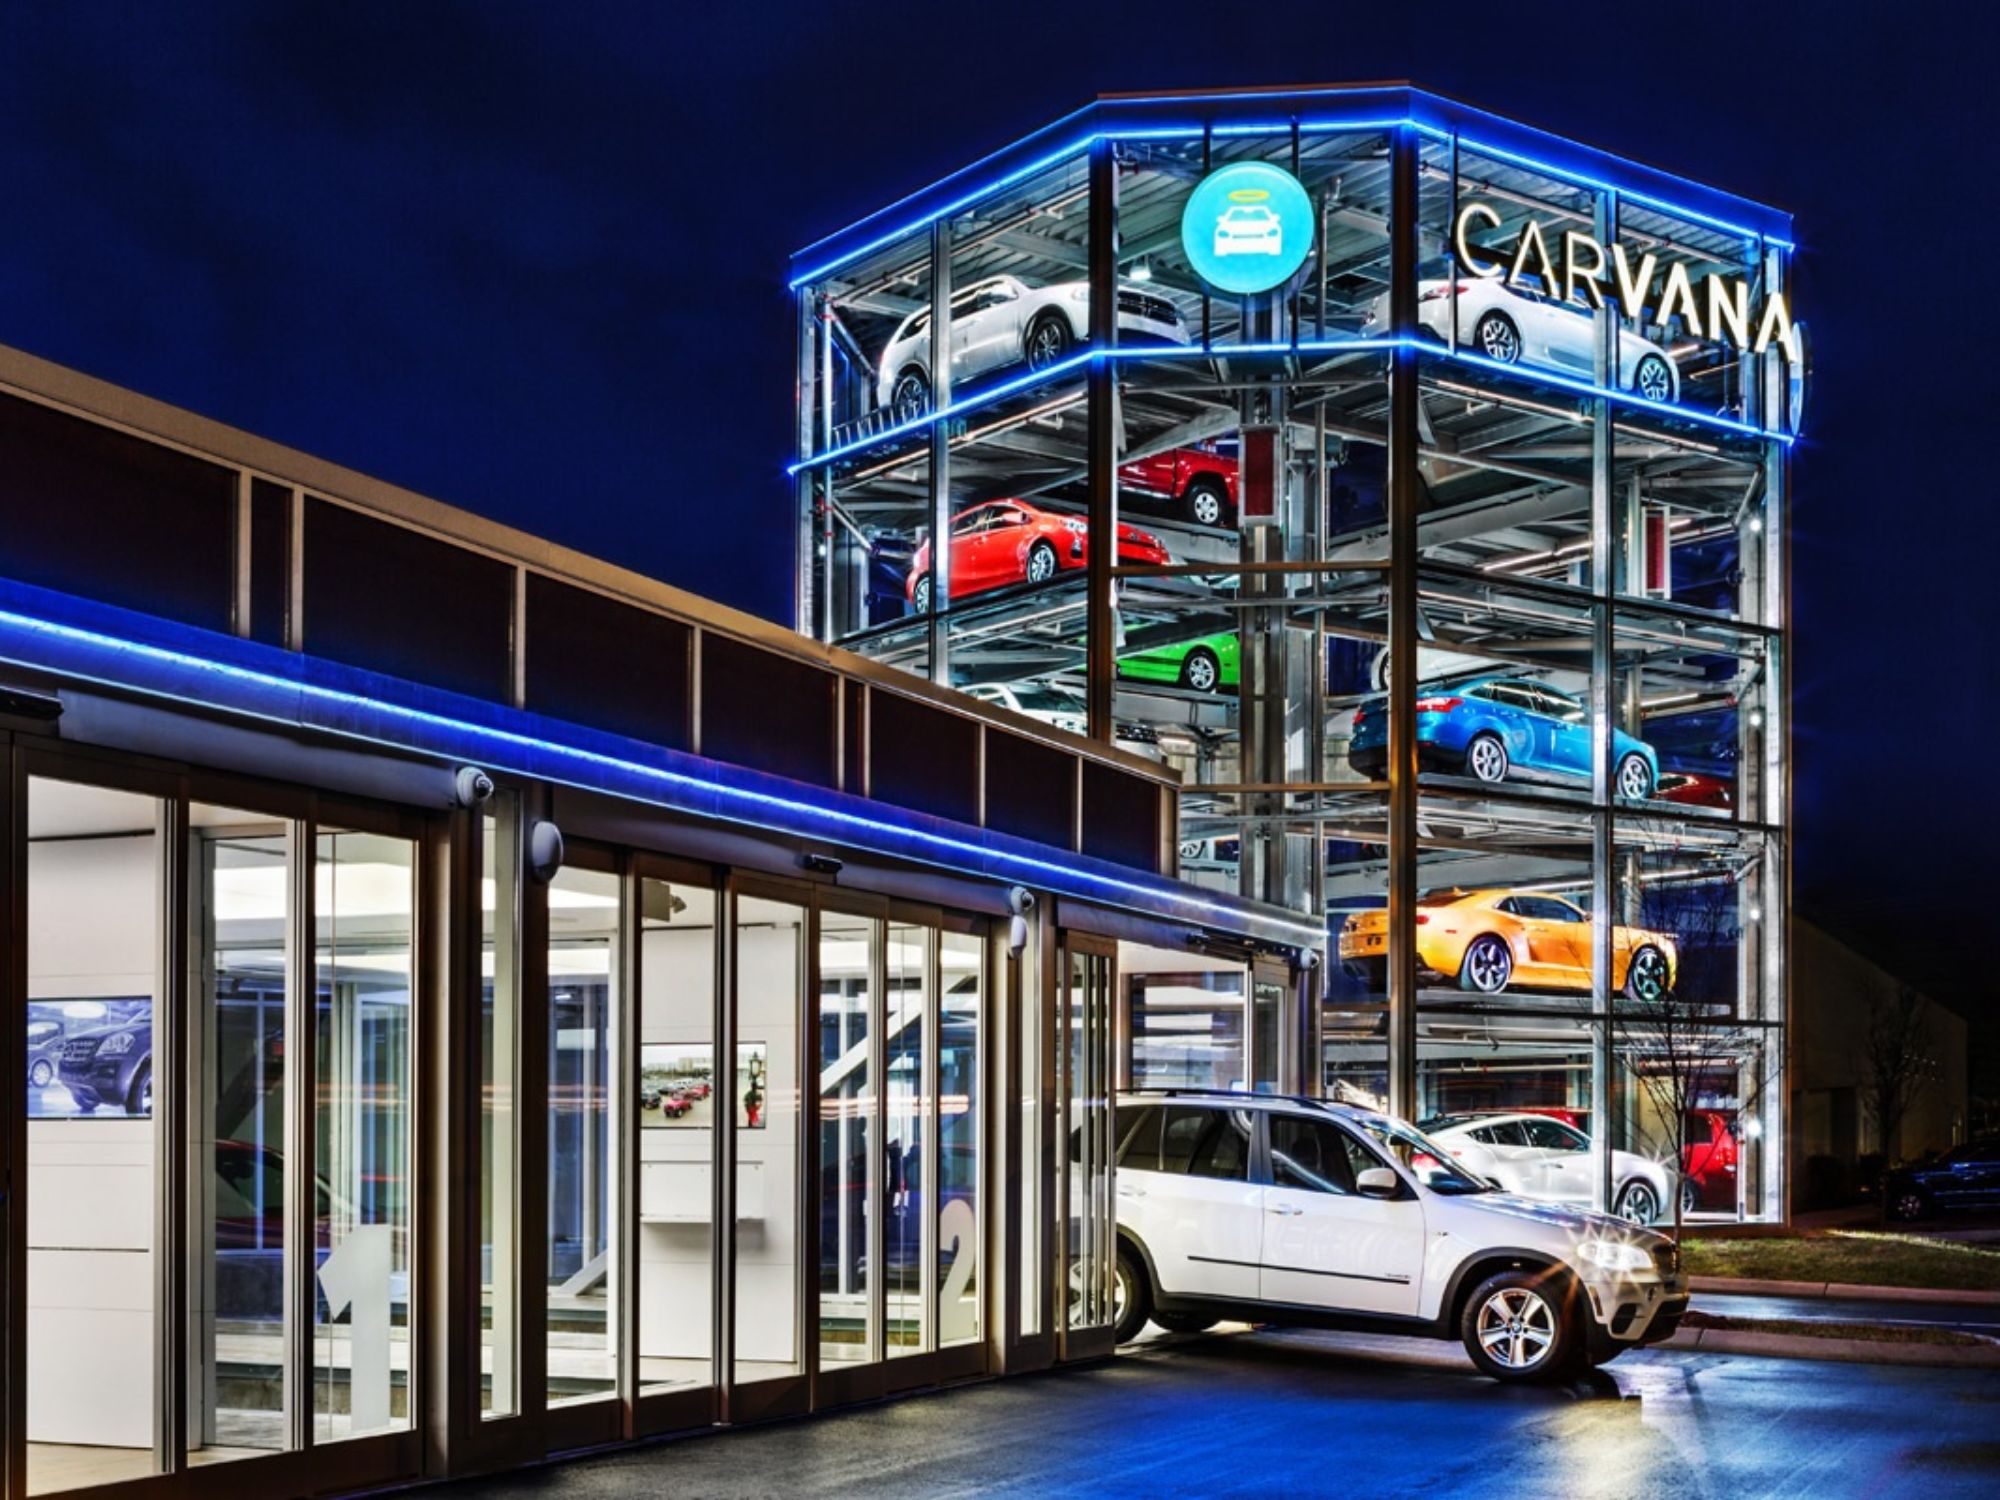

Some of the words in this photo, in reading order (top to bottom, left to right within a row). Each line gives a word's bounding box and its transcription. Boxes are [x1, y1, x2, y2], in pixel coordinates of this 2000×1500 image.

[1455, 203, 1797, 363] CARVANA
[317, 1224, 391, 1431] 1
[939, 1198, 976, 1342] 2
